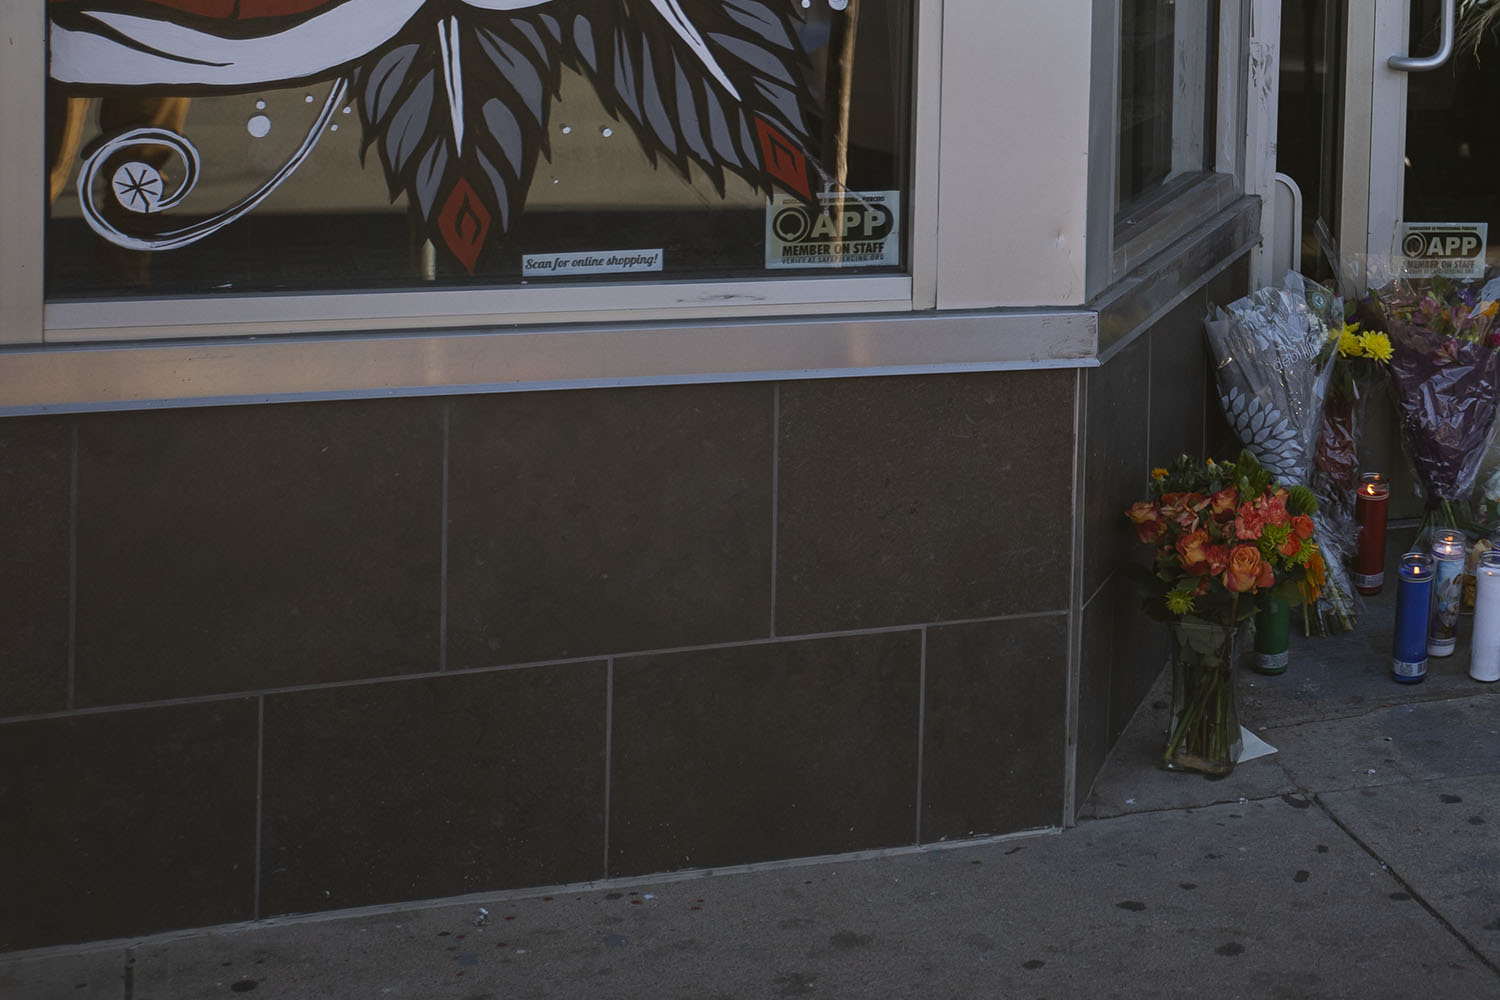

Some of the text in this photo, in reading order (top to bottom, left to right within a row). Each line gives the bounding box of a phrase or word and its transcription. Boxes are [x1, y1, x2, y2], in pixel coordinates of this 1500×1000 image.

[810, 210, 887, 239] APP
[782, 242, 885, 257] MEMBER ON STAFF
[1426, 236, 1478, 257] APP
[525, 253, 659, 272] Scan for online shopping!
